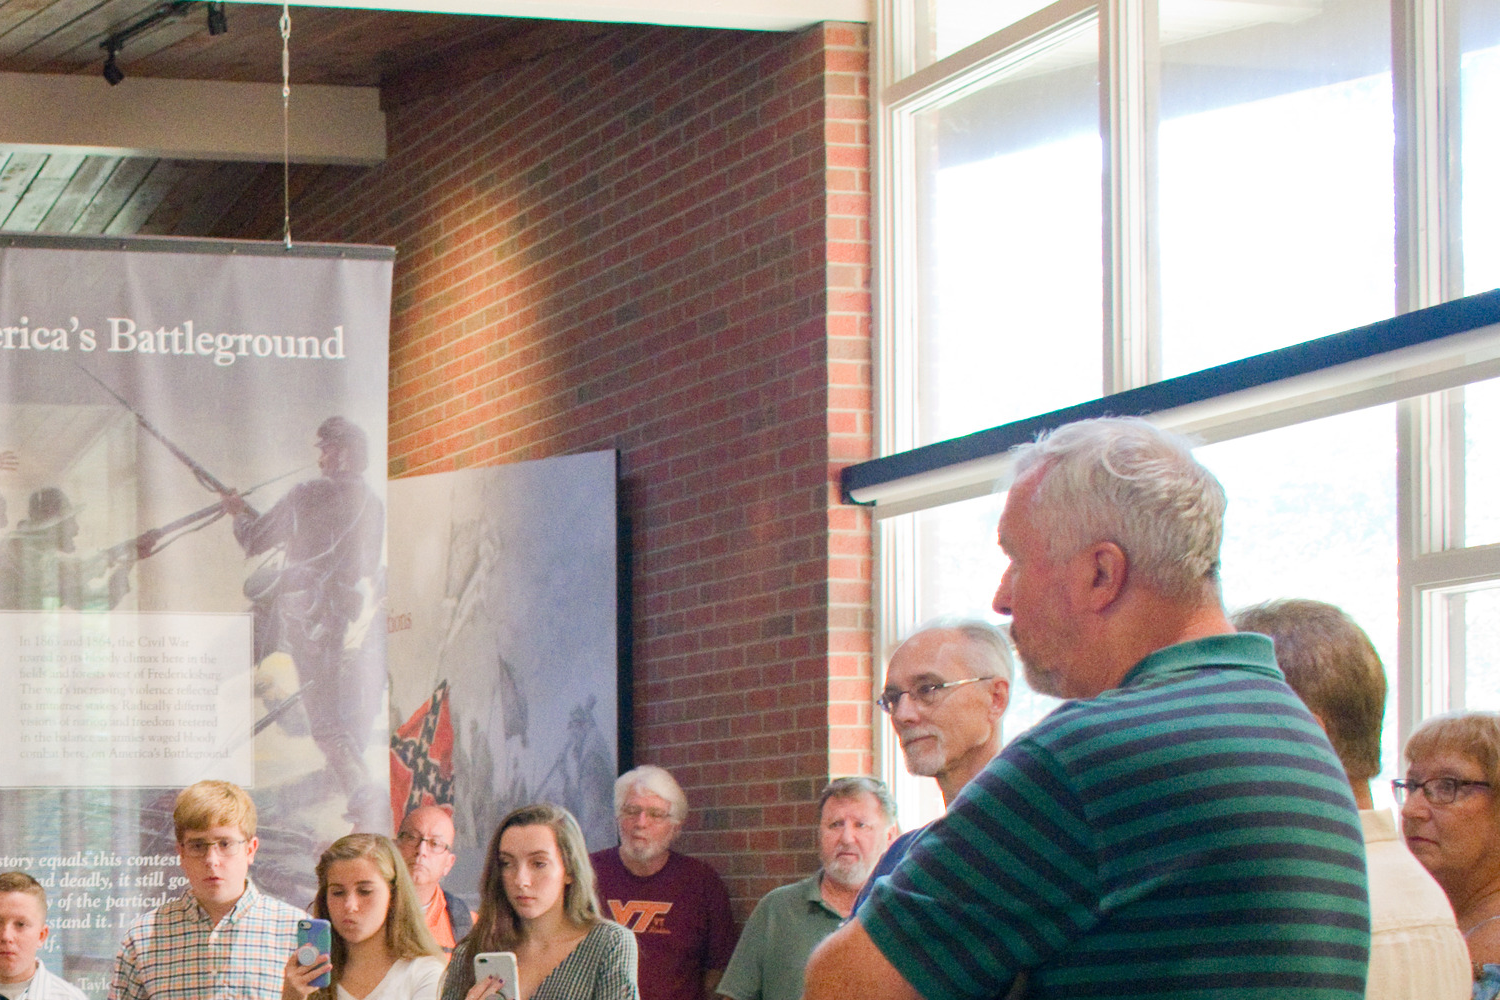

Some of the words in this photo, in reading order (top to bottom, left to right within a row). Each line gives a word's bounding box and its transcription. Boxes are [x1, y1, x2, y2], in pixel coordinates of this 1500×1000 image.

[107, 317, 346, 366] Battleground
[19, 636, 31, 648] In
[63, 635, 83, 648] and
[117, 636, 135, 648] the
[138, 636, 165, 648] Civil
[168, 637, 190, 648] War
[19, 652, 53, 664] roared
[56, 653, 67, 664] to
[70, 652, 82, 664] its
[123, 652, 159, 664] climax
[162, 652, 185, 664] here
[187, 653, 198, 664] in
[200, 652, 217, 665] the
[49, 667, 69, 680] and
[72, 667, 106, 680] forests
[108, 669, 131, 680] west
[134, 667, 145, 680] of
[20, 684, 42, 696] The
[73, 684, 126, 698] increasing
[129, 684, 174, 696] violence
[176, 684, 219, 696] reflected
[20, 700, 33, 711] its
[35, 700, 83, 711] immense
[122, 700, 171, 714] Radically
[174, 700, 216, 711] different
[59, 715, 70, 727] of
[110, 715, 130, 727] and
[132, 715, 175, 727] freedom
[178, 716, 218, 728] teetered
[20, 732, 31, 743] in
[34, 731, 52, 743] the
[54, 731, 94, 743] balance
[111, 732, 145, 743] armies
[148, 732, 181, 745] waged
[183, 731, 217, 745] bloody
[19, 747, 59, 760] combat
[92, 750, 106, 760] on
[108, 748, 161, 760] America's
[38, 851, 89, 870] equals
[93, 850, 123, 867] this
[127, 853, 182, 867] contest
[35, 871, 56, 888] nd
[60, 871, 113, 890] deadly,
[118, 871, 131, 887] it
[134, 871, 165, 887] still
[57, 892, 74, 911] of
[76, 892, 101, 909] the
[95, 914, 113, 930] it.
[607, 900, 674, 933] VT
